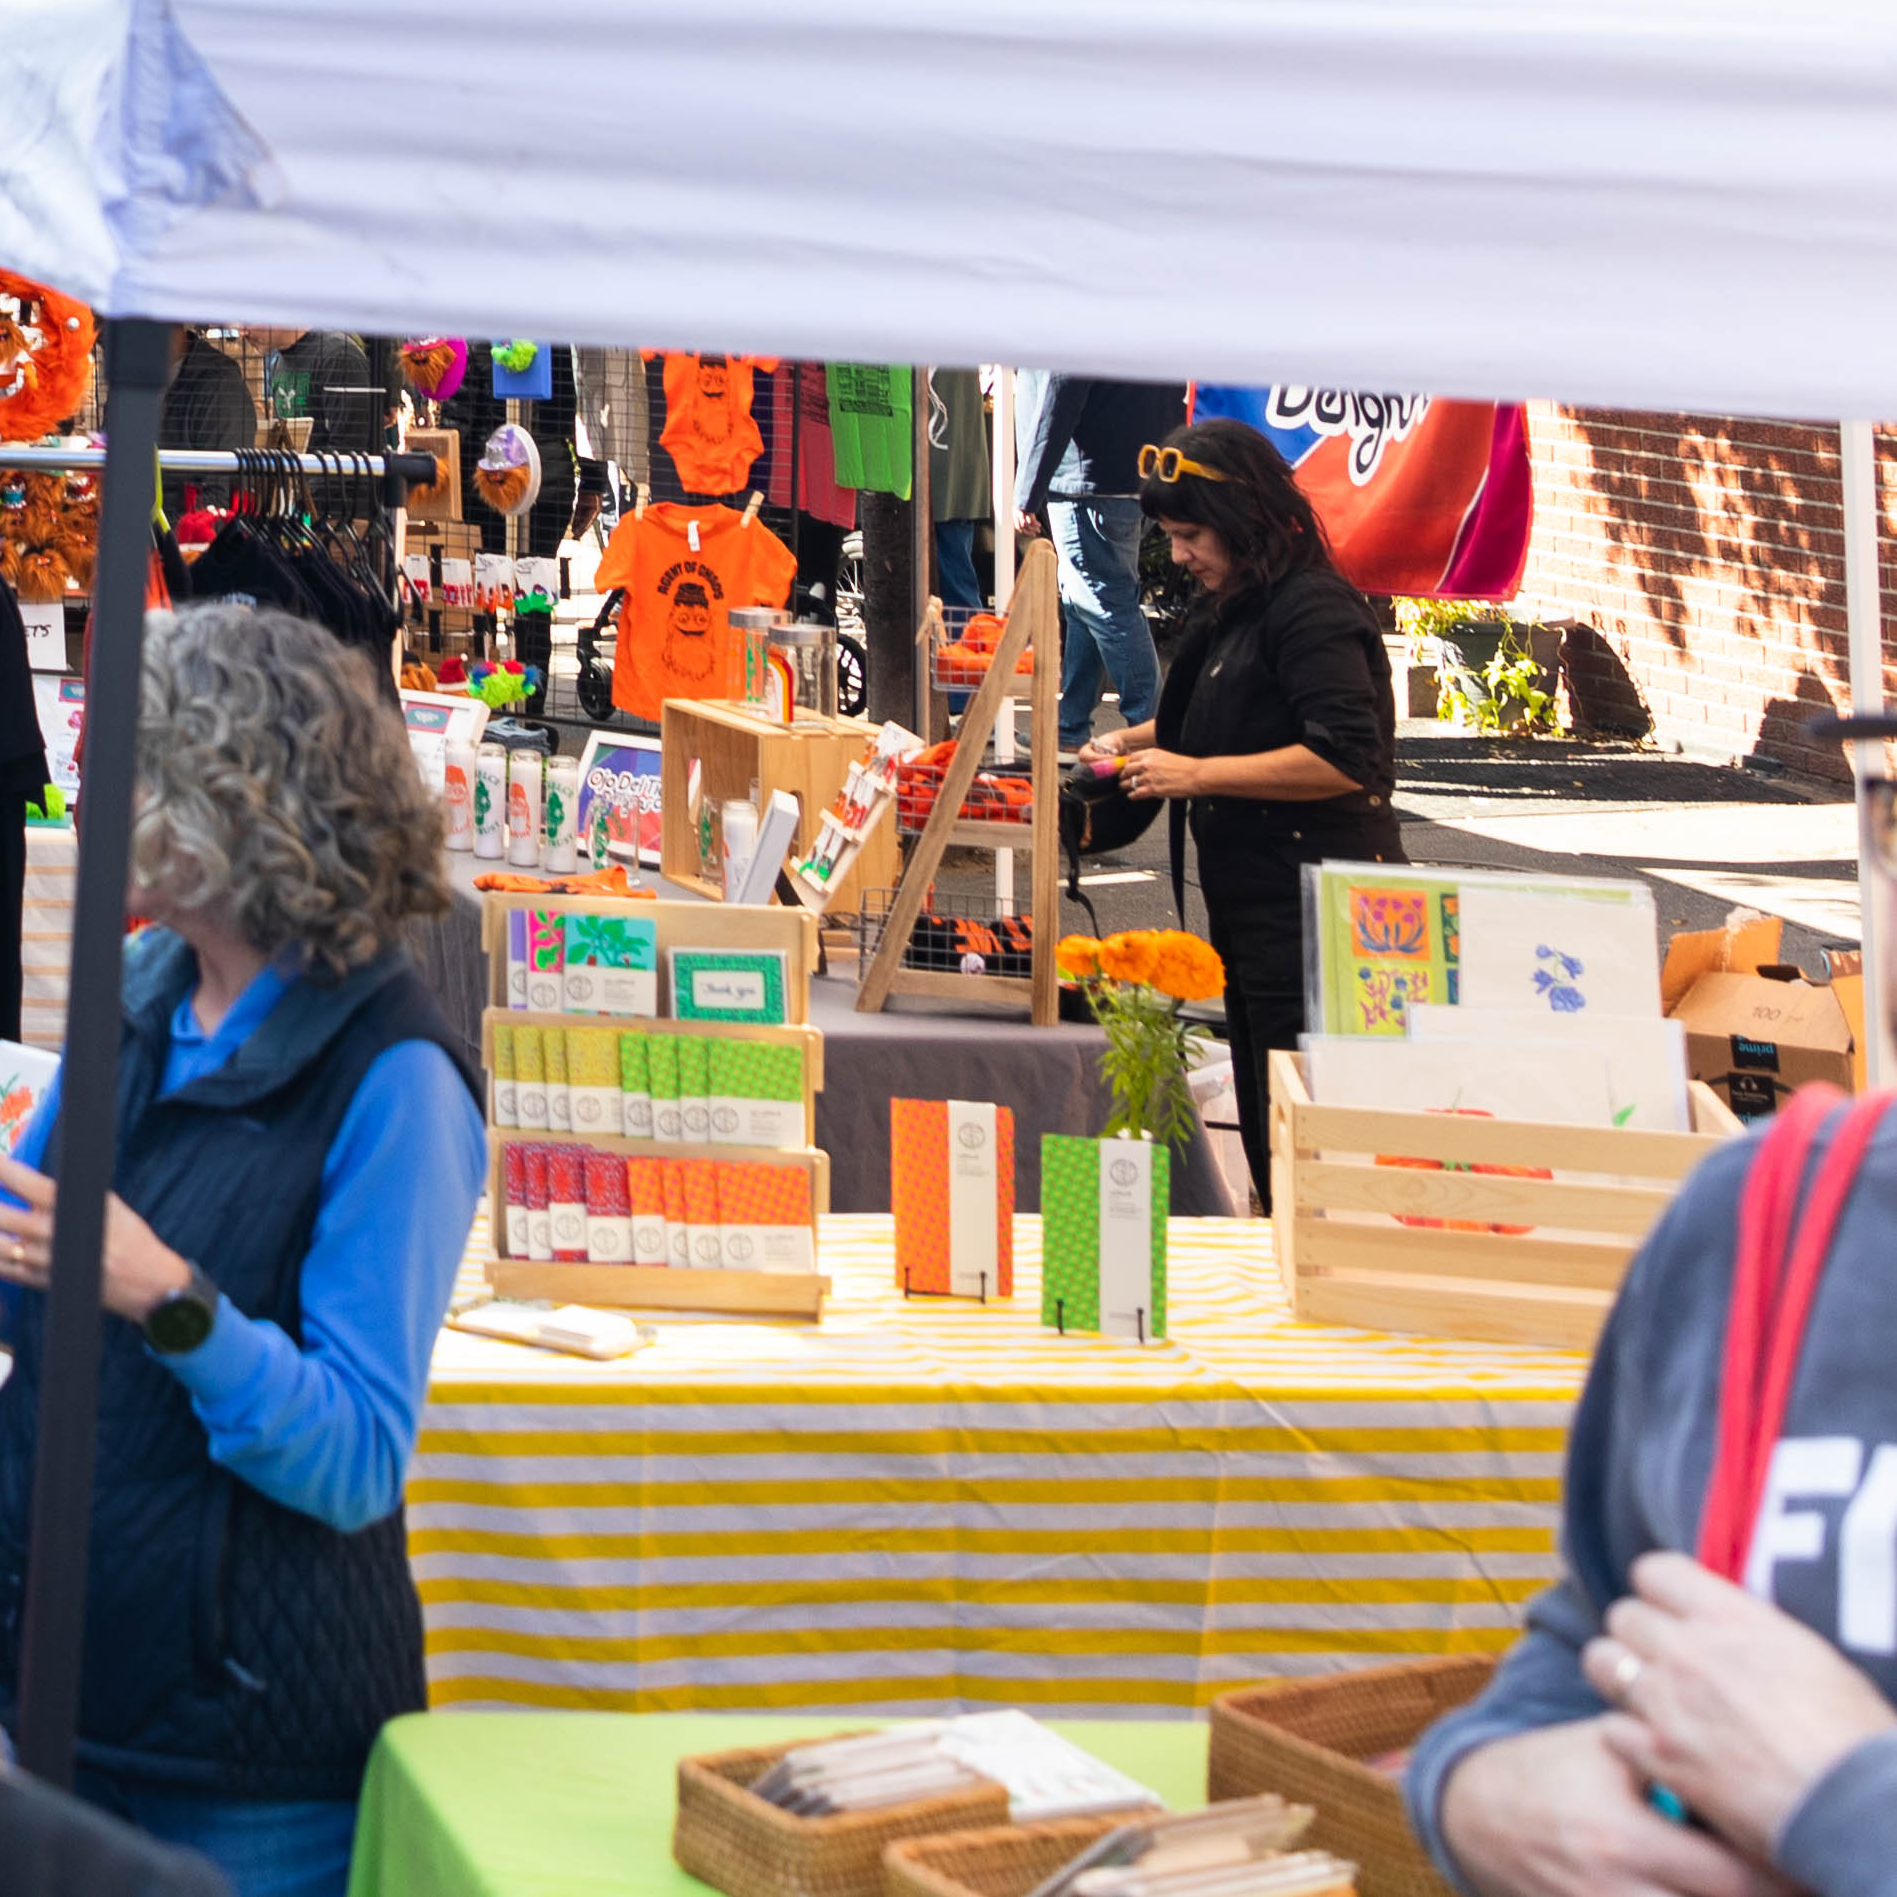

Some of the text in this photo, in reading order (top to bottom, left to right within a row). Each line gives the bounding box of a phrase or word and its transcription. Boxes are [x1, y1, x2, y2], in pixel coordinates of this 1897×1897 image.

[657, 562, 683, 595] AGENT
[684, 560, 697, 574] OF
[1738, 1041, 1775, 1055] prime
